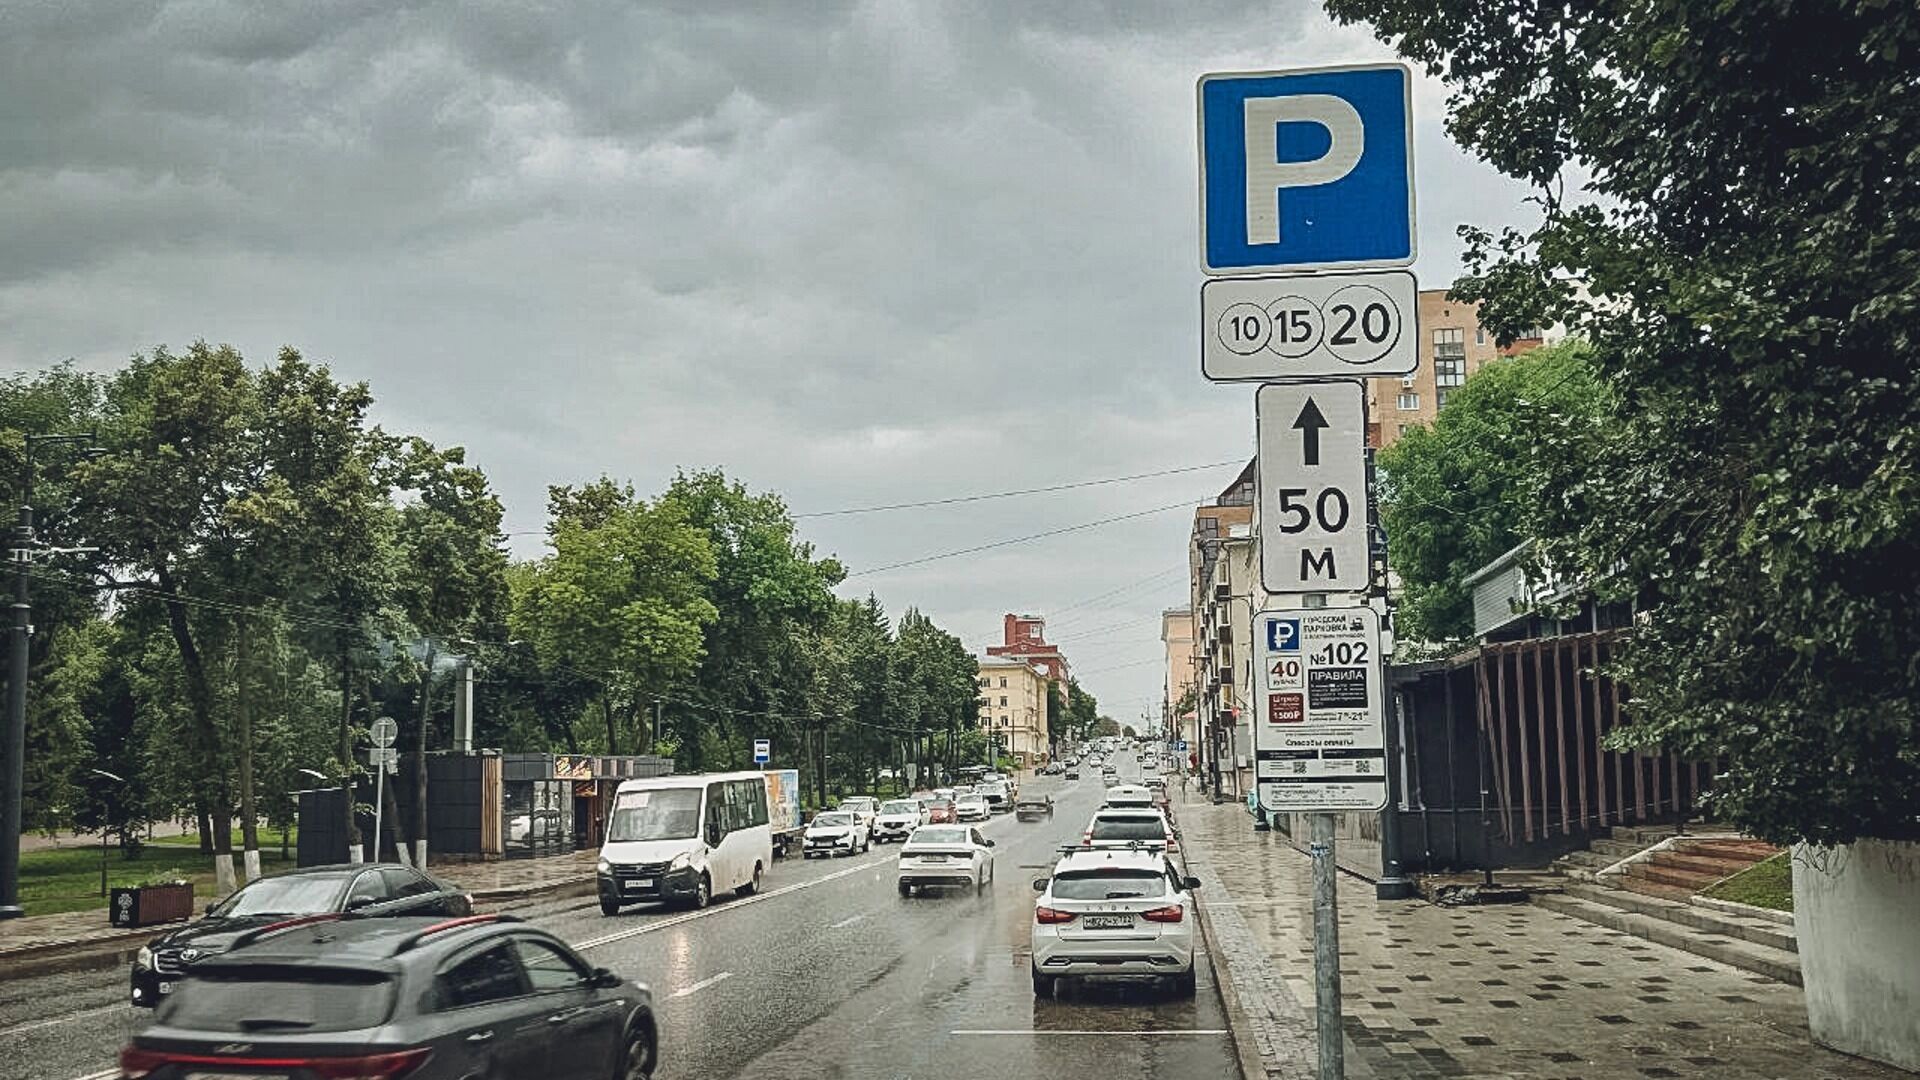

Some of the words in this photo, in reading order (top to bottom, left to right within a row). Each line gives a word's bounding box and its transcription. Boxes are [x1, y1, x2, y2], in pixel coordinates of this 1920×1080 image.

[1244, 94, 1364, 245] P
[1231, 315, 1260, 342] 10
[1274, 309, 1312, 344] 15
[1330, 303, 1391, 346] 20
[1279, 487, 1349, 534] 50
[1303, 624, 1348, 632] ПАРКОВКА
[1310, 641, 1369, 666] №102
[1271, 661, 1300, 677] 40
[1310, 670, 1364, 681] ПРАВИЛА
